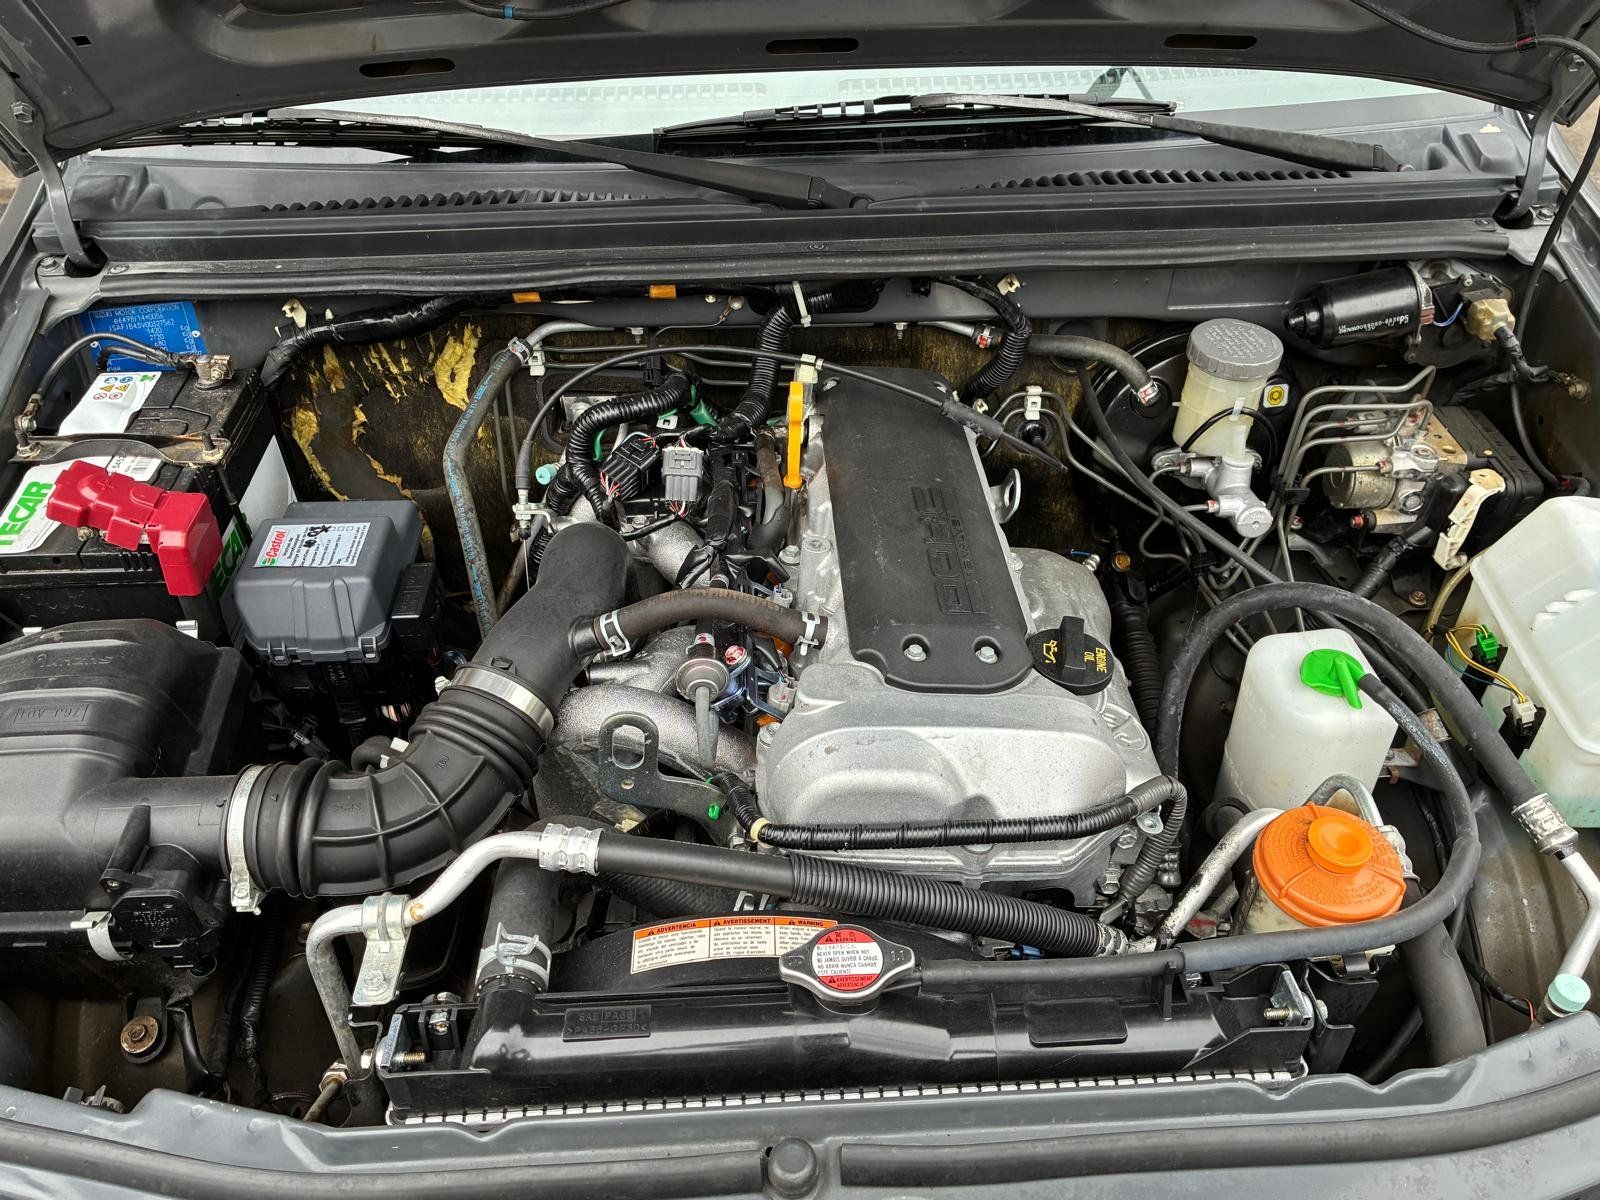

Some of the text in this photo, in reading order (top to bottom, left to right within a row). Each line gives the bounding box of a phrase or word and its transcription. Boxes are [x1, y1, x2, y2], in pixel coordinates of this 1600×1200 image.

[115, 308, 138, 316] MOTOR
[138, 303, 179, 314] CORPORATION
[265, 530, 288, 558] Castrol
[1083, 651, 1091, 663] OIL
[1095, 647, 1108, 674] ENGINE
[657, 923, 696, 933] ADVERTENCIA
